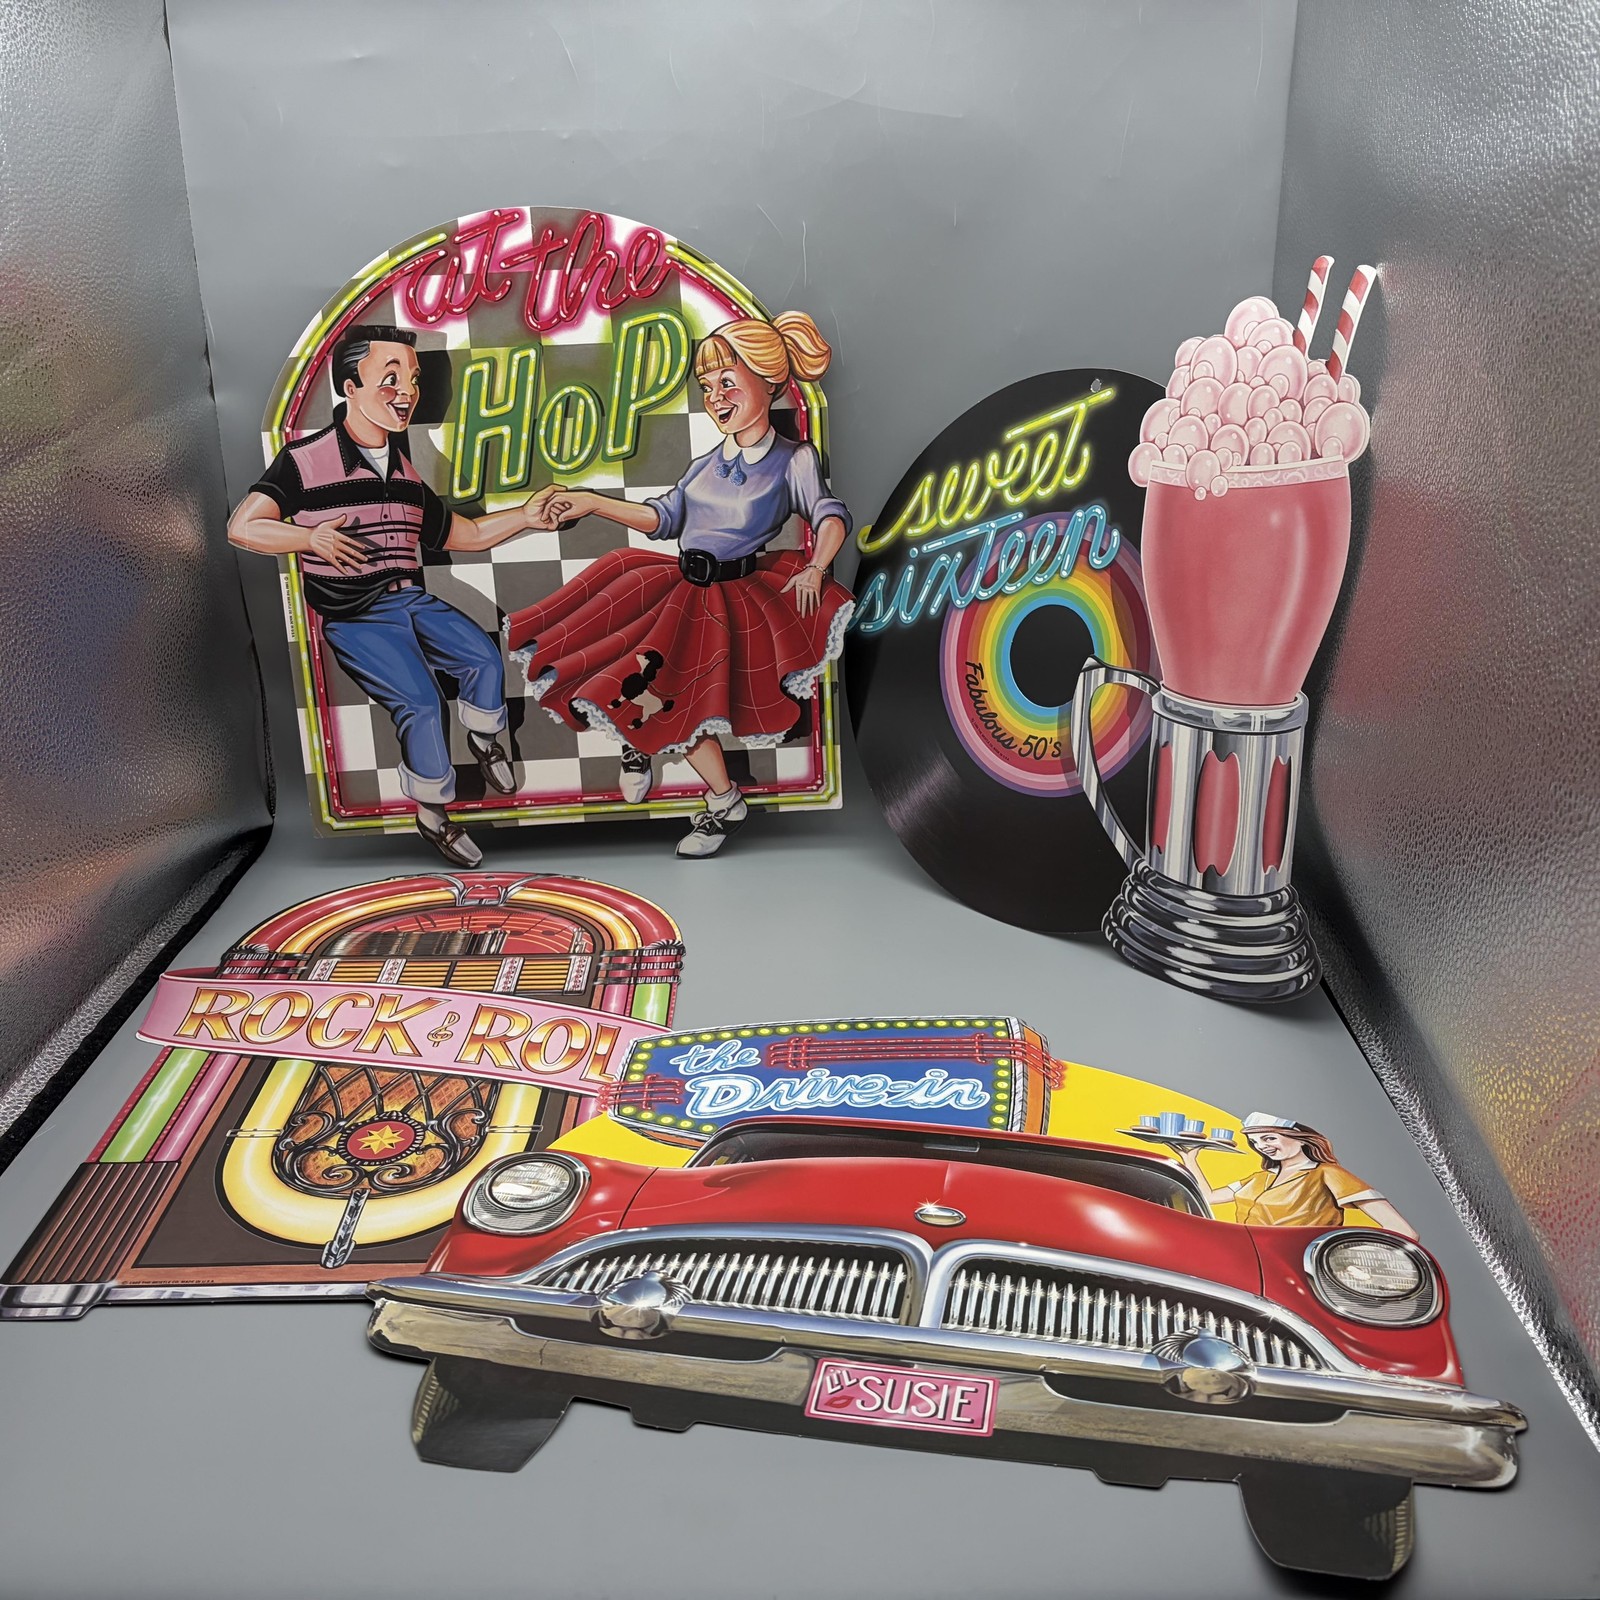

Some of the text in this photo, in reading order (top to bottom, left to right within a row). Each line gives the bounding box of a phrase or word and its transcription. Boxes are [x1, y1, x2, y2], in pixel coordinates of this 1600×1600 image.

[406, 209, 671, 331] at the
[857, 388, 1114, 552] sweet
[848, 504, 1120, 632] sixteen
[965, 661, 1018, 750] Fabulous
[1017, 734, 1062, 760] 50's
[173, 986, 622, 1084] ROCK ROL
[670, 1040, 761, 1077] the
[685, 1068, 990, 1117] Drive-in
[856, 1375, 977, 1423] SUSIE
